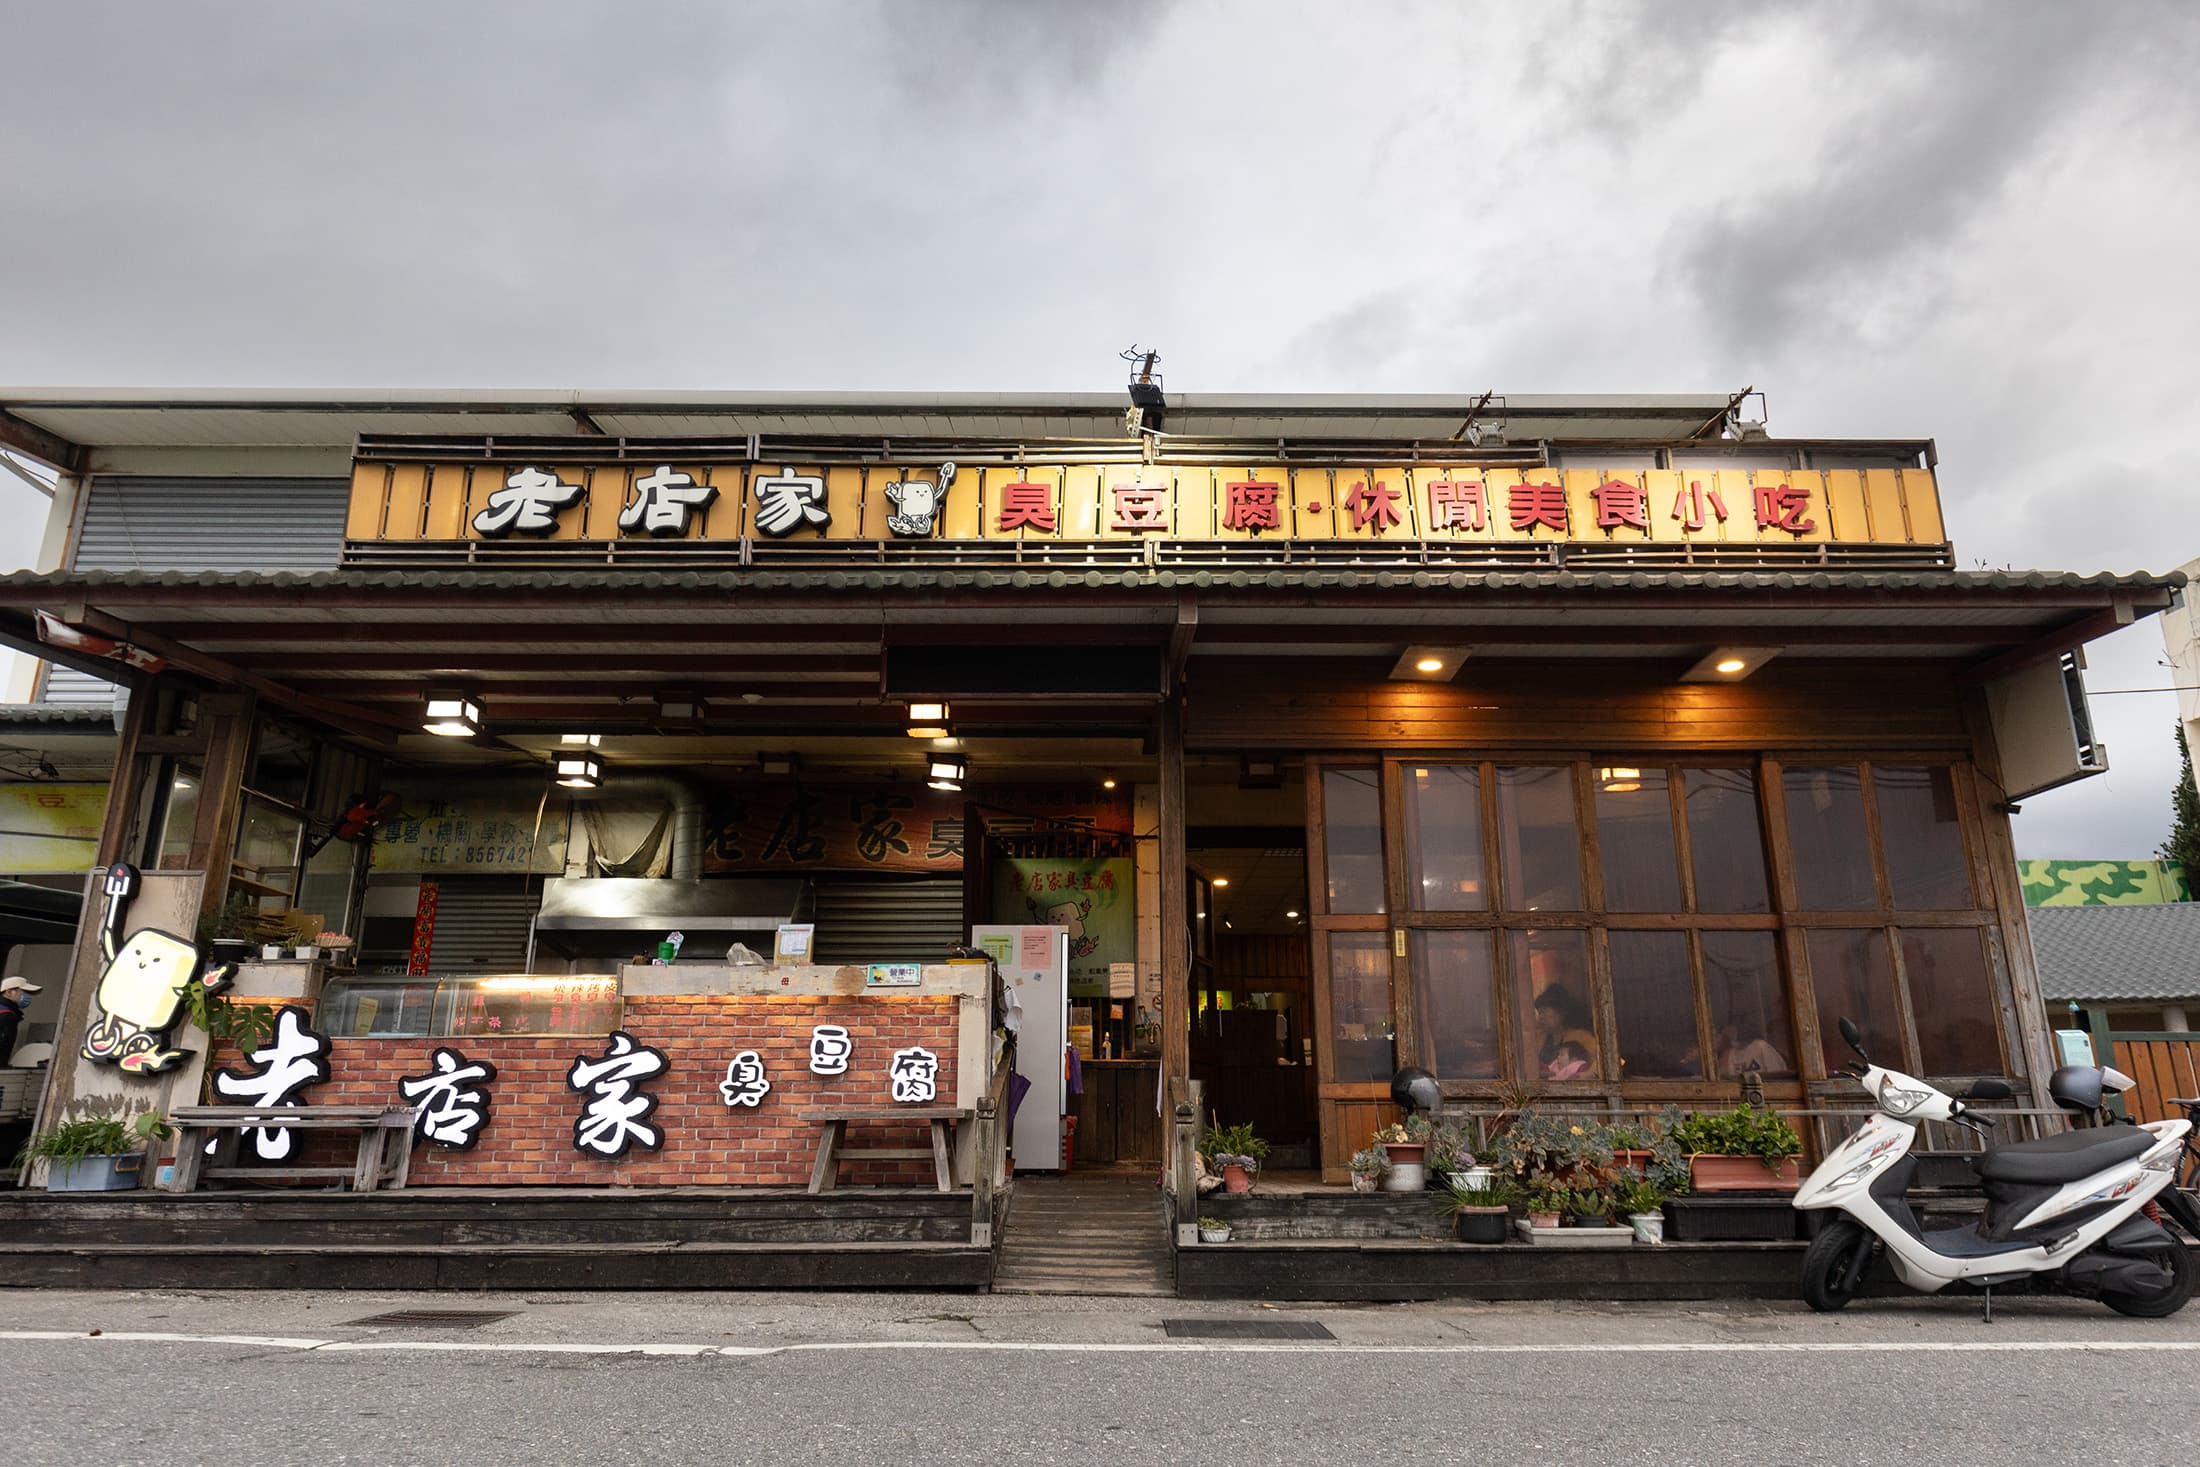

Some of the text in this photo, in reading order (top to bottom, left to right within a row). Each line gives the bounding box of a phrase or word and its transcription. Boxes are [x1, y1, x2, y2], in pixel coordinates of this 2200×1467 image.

[473, 465, 832, 537] 老店家
[204, 1010, 936, 1160] 老店家 臭豆腐
